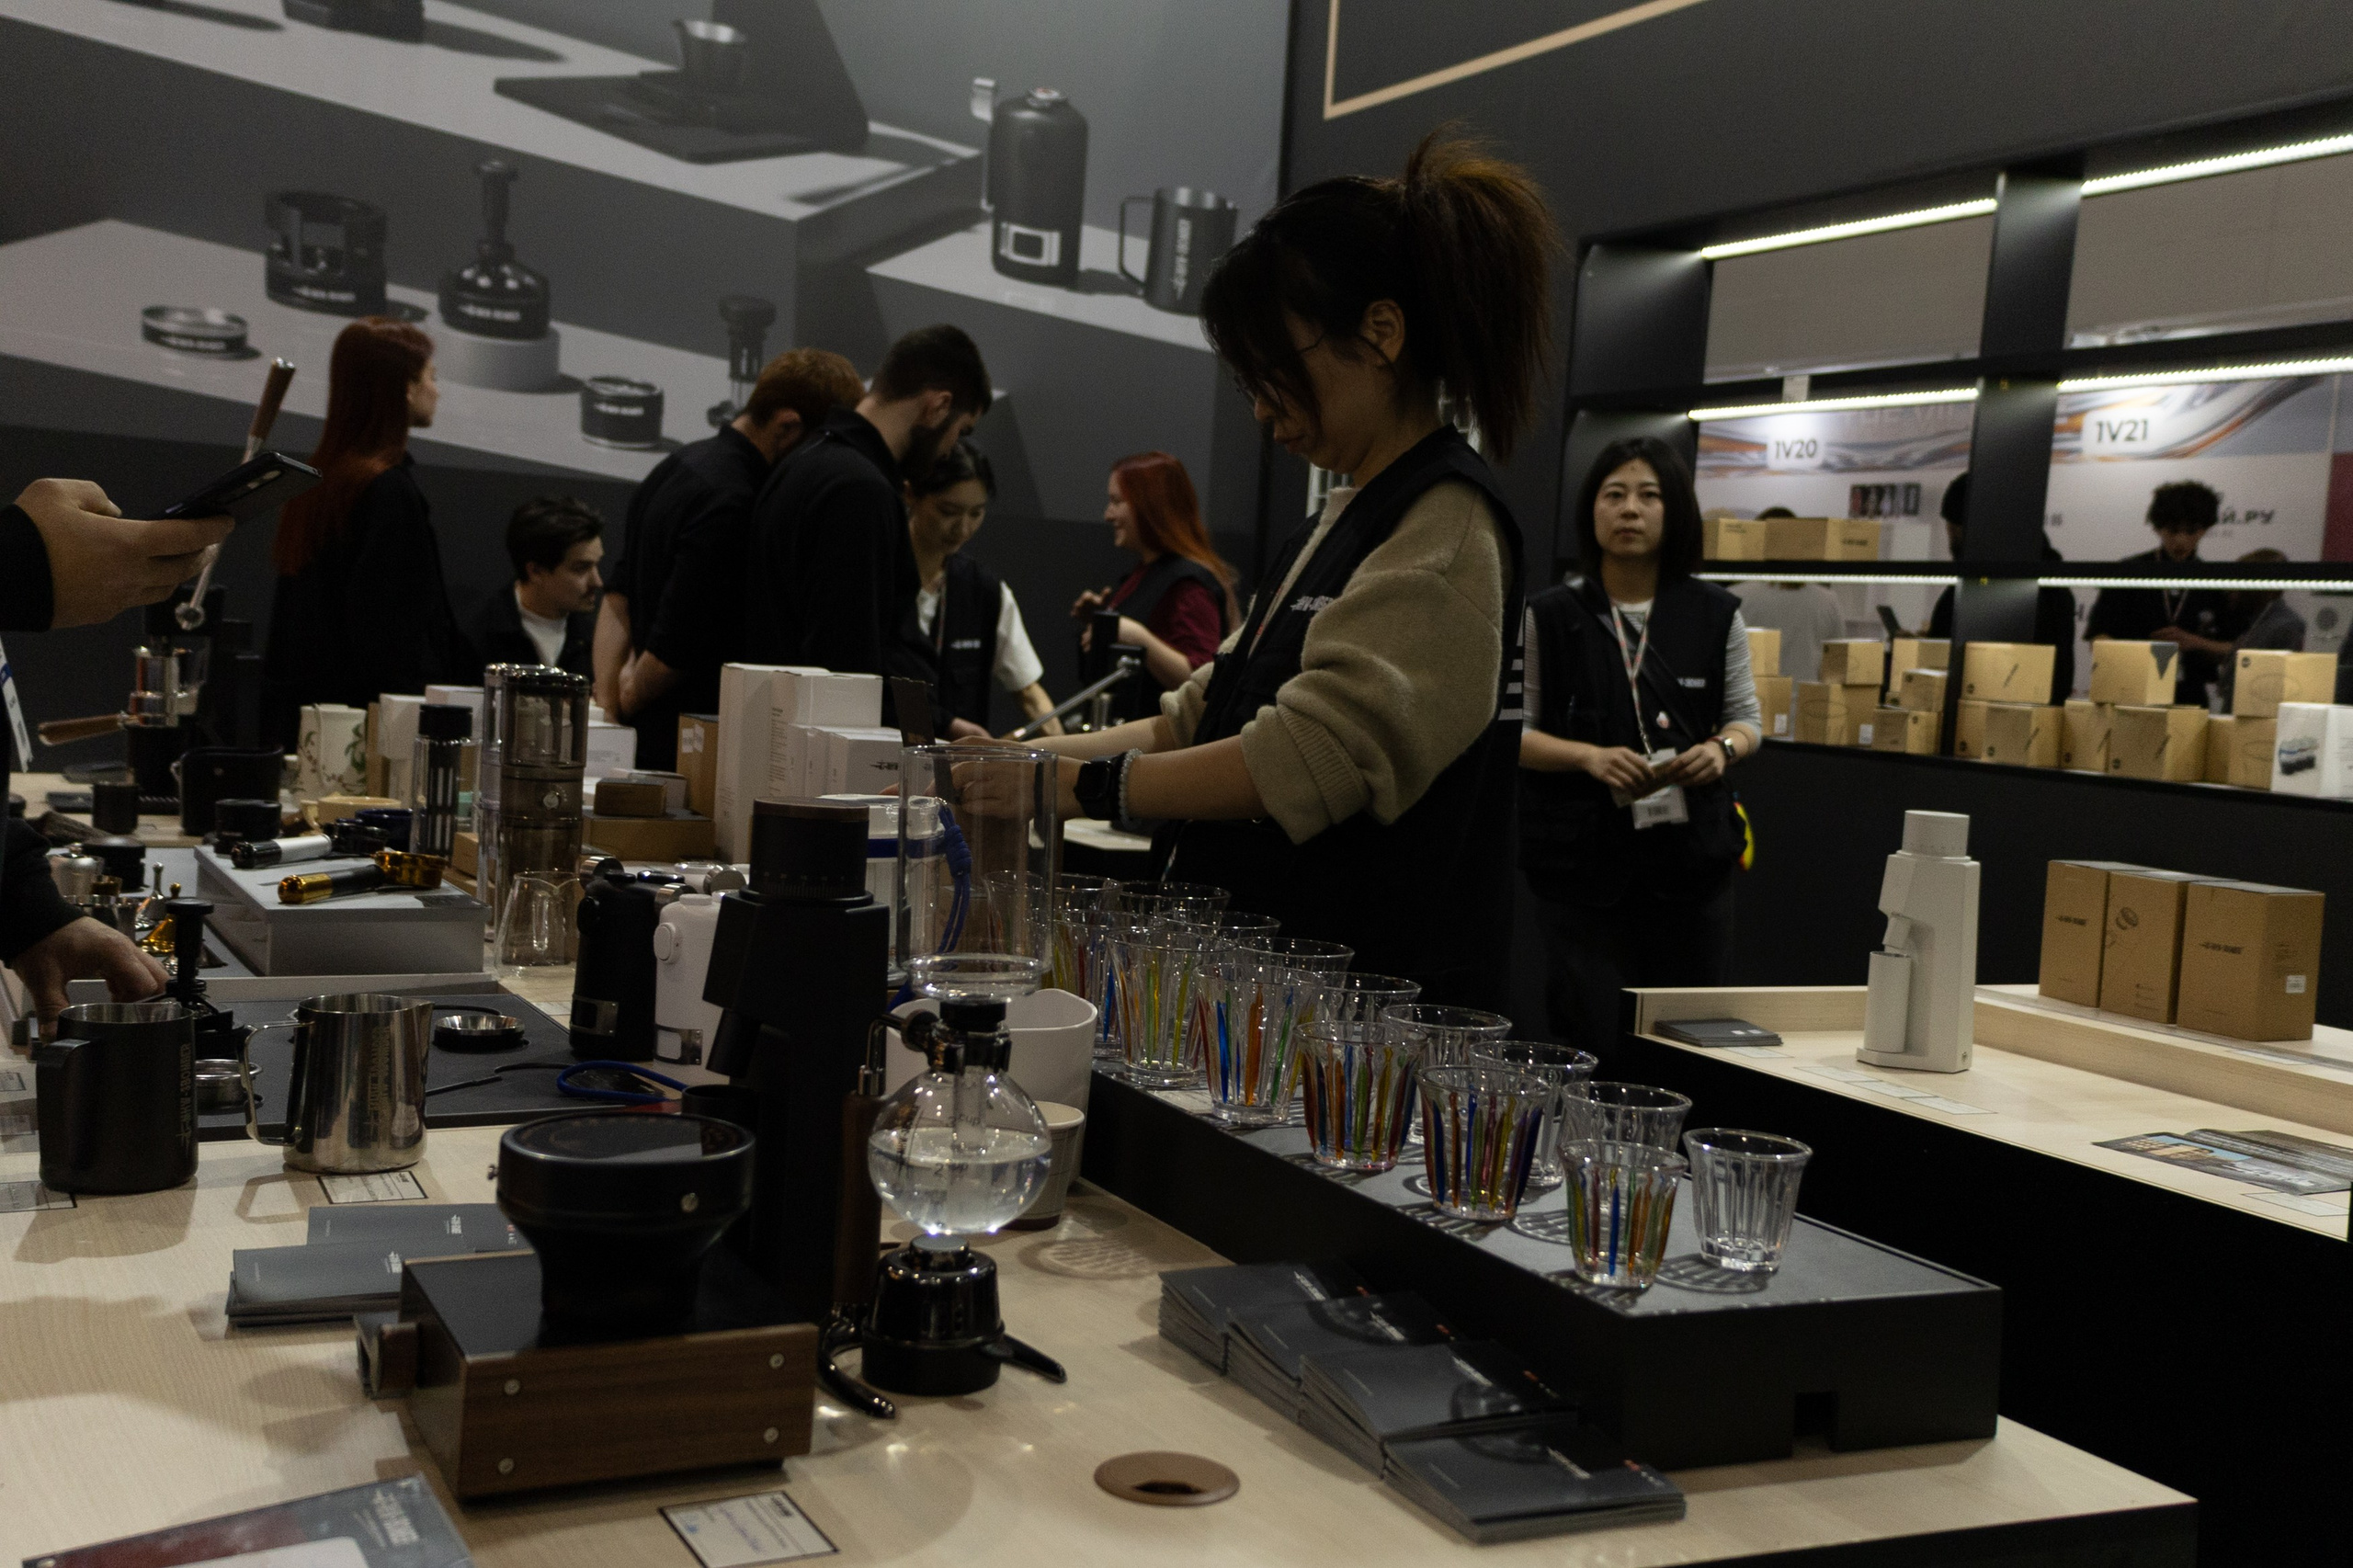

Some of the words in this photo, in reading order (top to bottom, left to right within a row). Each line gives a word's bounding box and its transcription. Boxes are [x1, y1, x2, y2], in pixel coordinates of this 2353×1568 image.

[2096, 416, 2149, 446] 1V21
[1775, 437, 1818, 459] 1V20
[933, 1162, 944, 1177] 2
